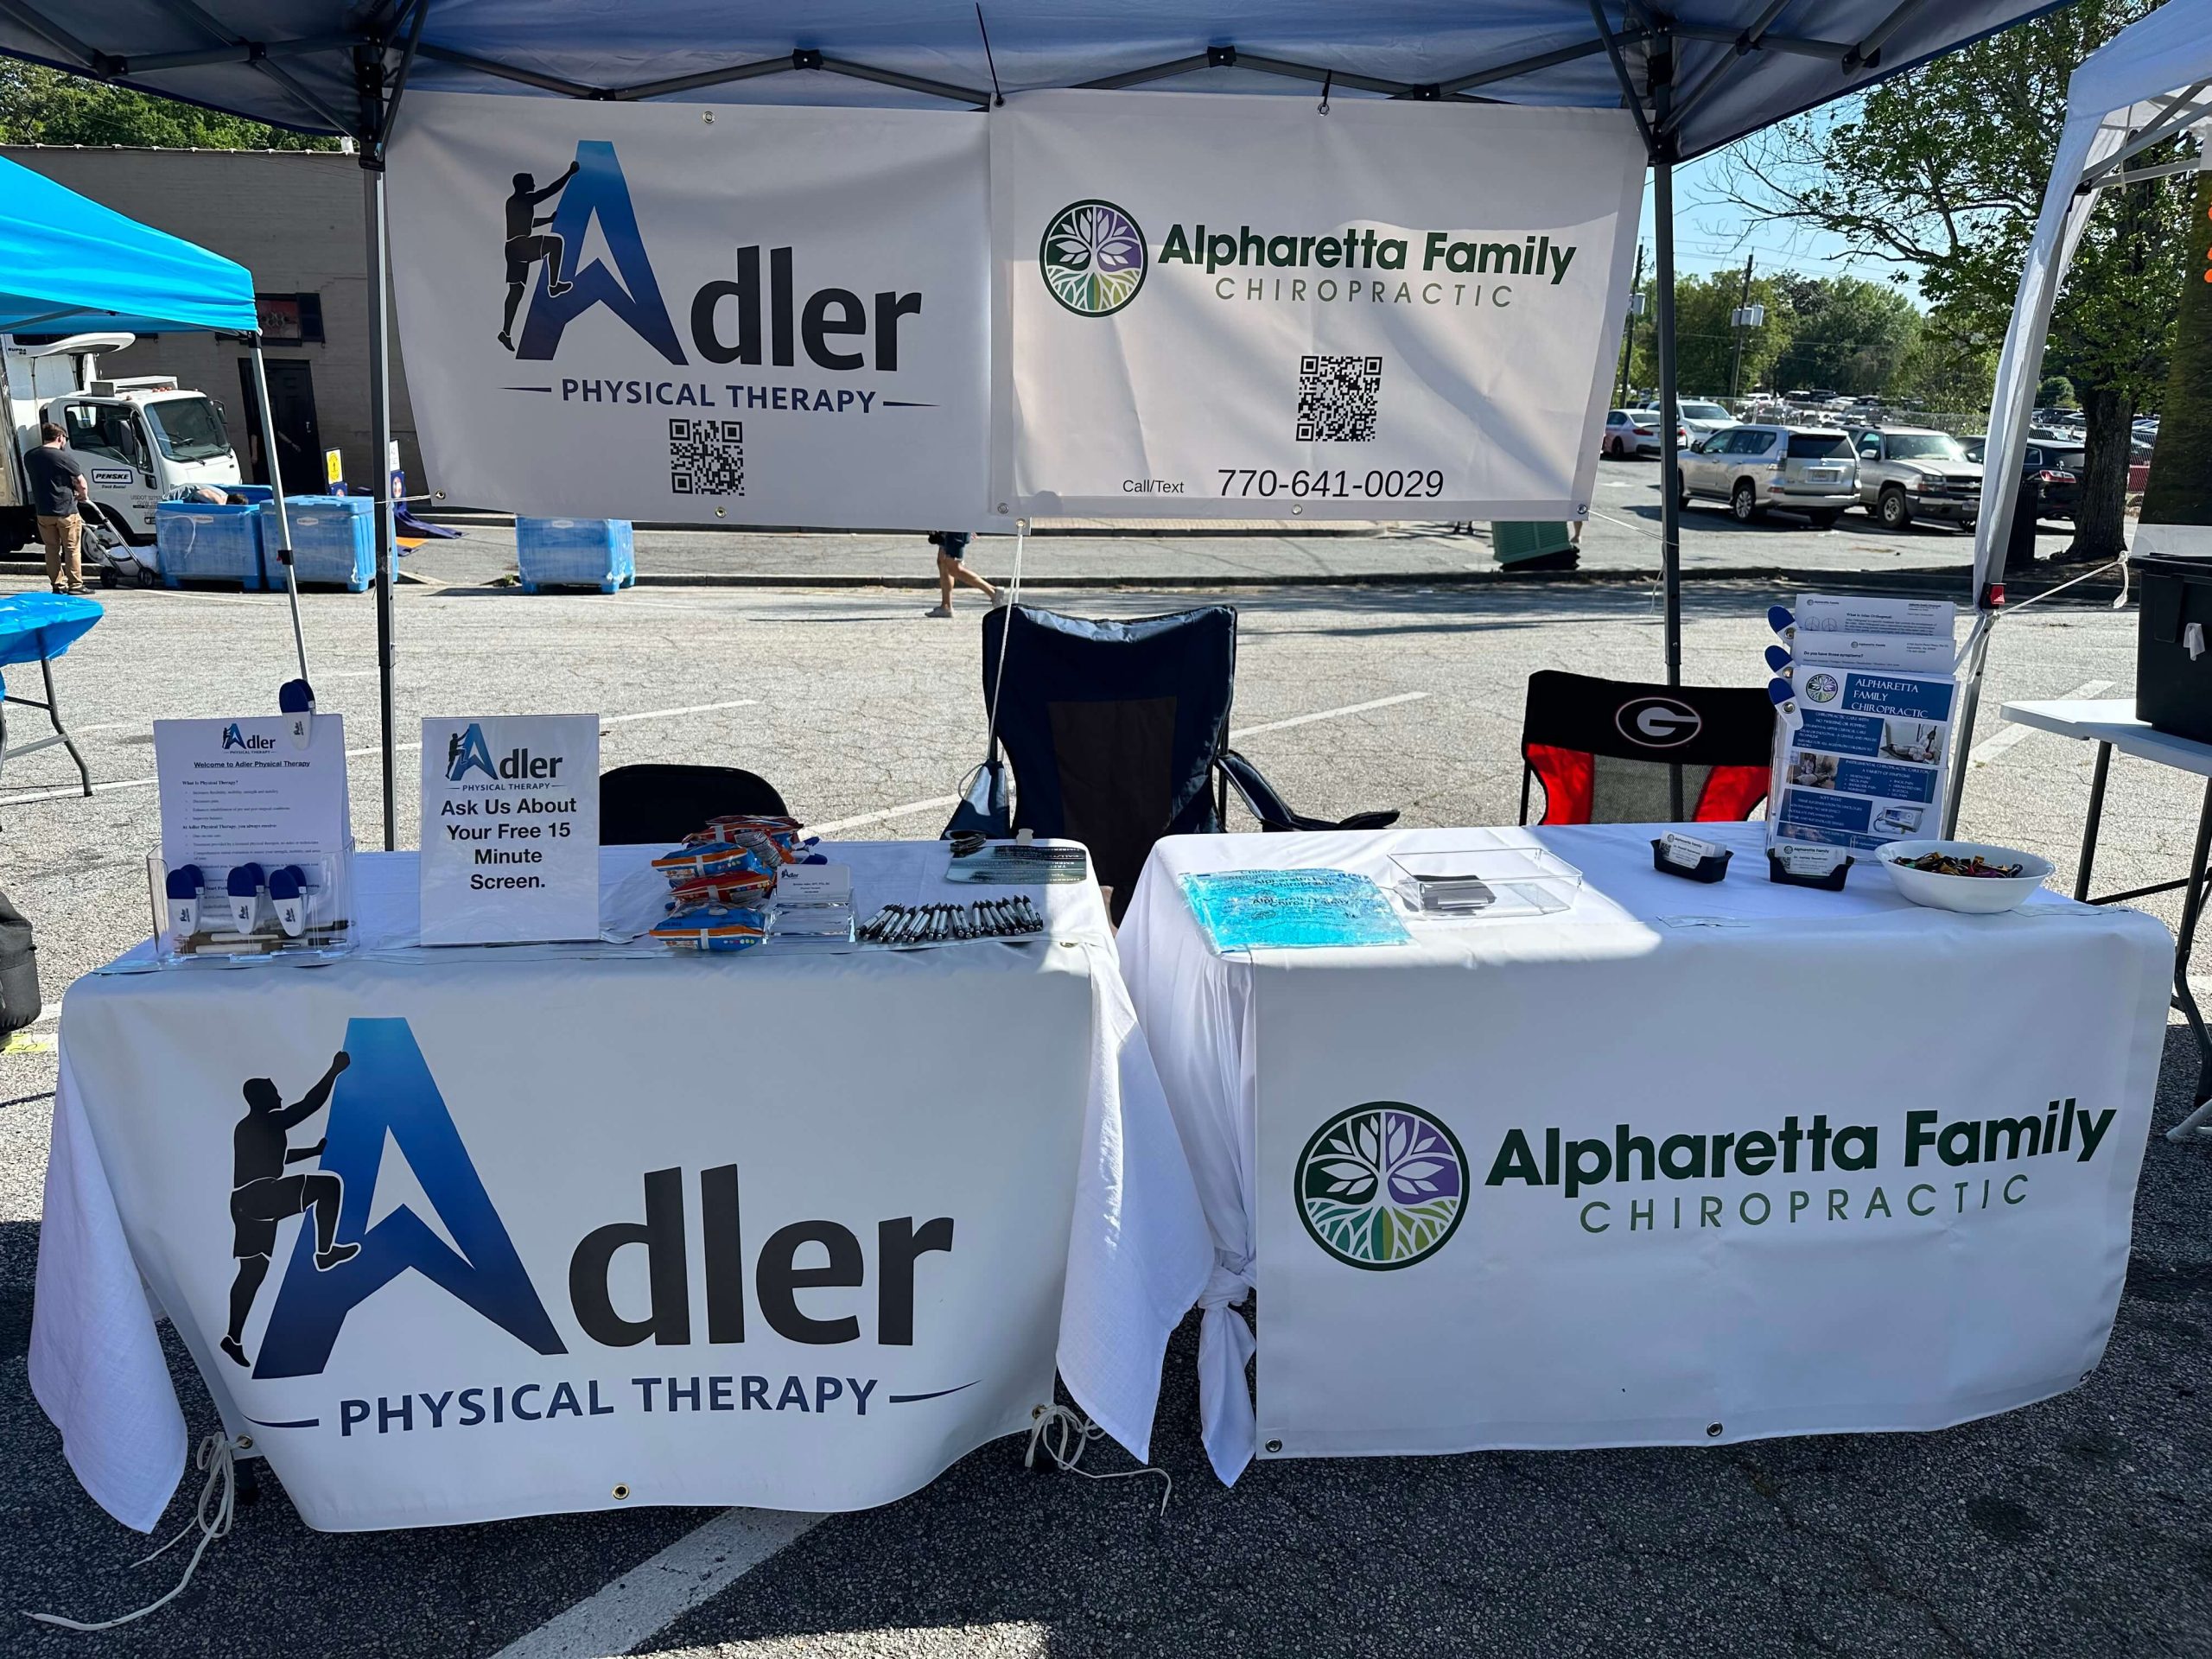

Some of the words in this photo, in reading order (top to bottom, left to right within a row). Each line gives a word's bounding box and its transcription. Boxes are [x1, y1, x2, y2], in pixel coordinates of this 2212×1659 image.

[516, 140, 922, 371] Adler
[1158, 224, 1408, 274] Alpharetta
[1421, 232, 1577, 284] Family
[1216, 277, 1513, 308] CHIROPRACTIC
[562, 378, 715, 407] PHYSICAL
[726, 385, 876, 413] THERAPY
[1122, 478, 1185, 494] Call/Text
[1217, 468, 1445, 498] 770-641-0029
[1853, 690, 1889, 702] FAMILY
[1855, 678, 1919, 693] ALPHARETTA
[1851, 702, 1929, 718] CHIROPRACTIC
[223, 723, 276, 749] Adler
[450, 723, 563, 781] Adler
[441, 799, 479, 816] Ask
[485, 798, 511, 815] Us
[517, 798, 577, 814] About
[446, 824, 492, 841] Your
[498, 823, 541, 839] Free
[548, 822, 571, 838] 15
[474, 849, 543, 865] Minute
[470, 874, 546, 890] Screen.
[1484, 1116, 1880, 1198] Alpharetta
[1904, 1097, 2117, 1168] Family
[251, 1017, 954, 1380] Adler
[1580, 1174, 2029, 1235] CHIROPRACTIC
[339, 1380, 615, 1438] PHYSICAL
[632, 1375, 879, 1417] THERAPY
